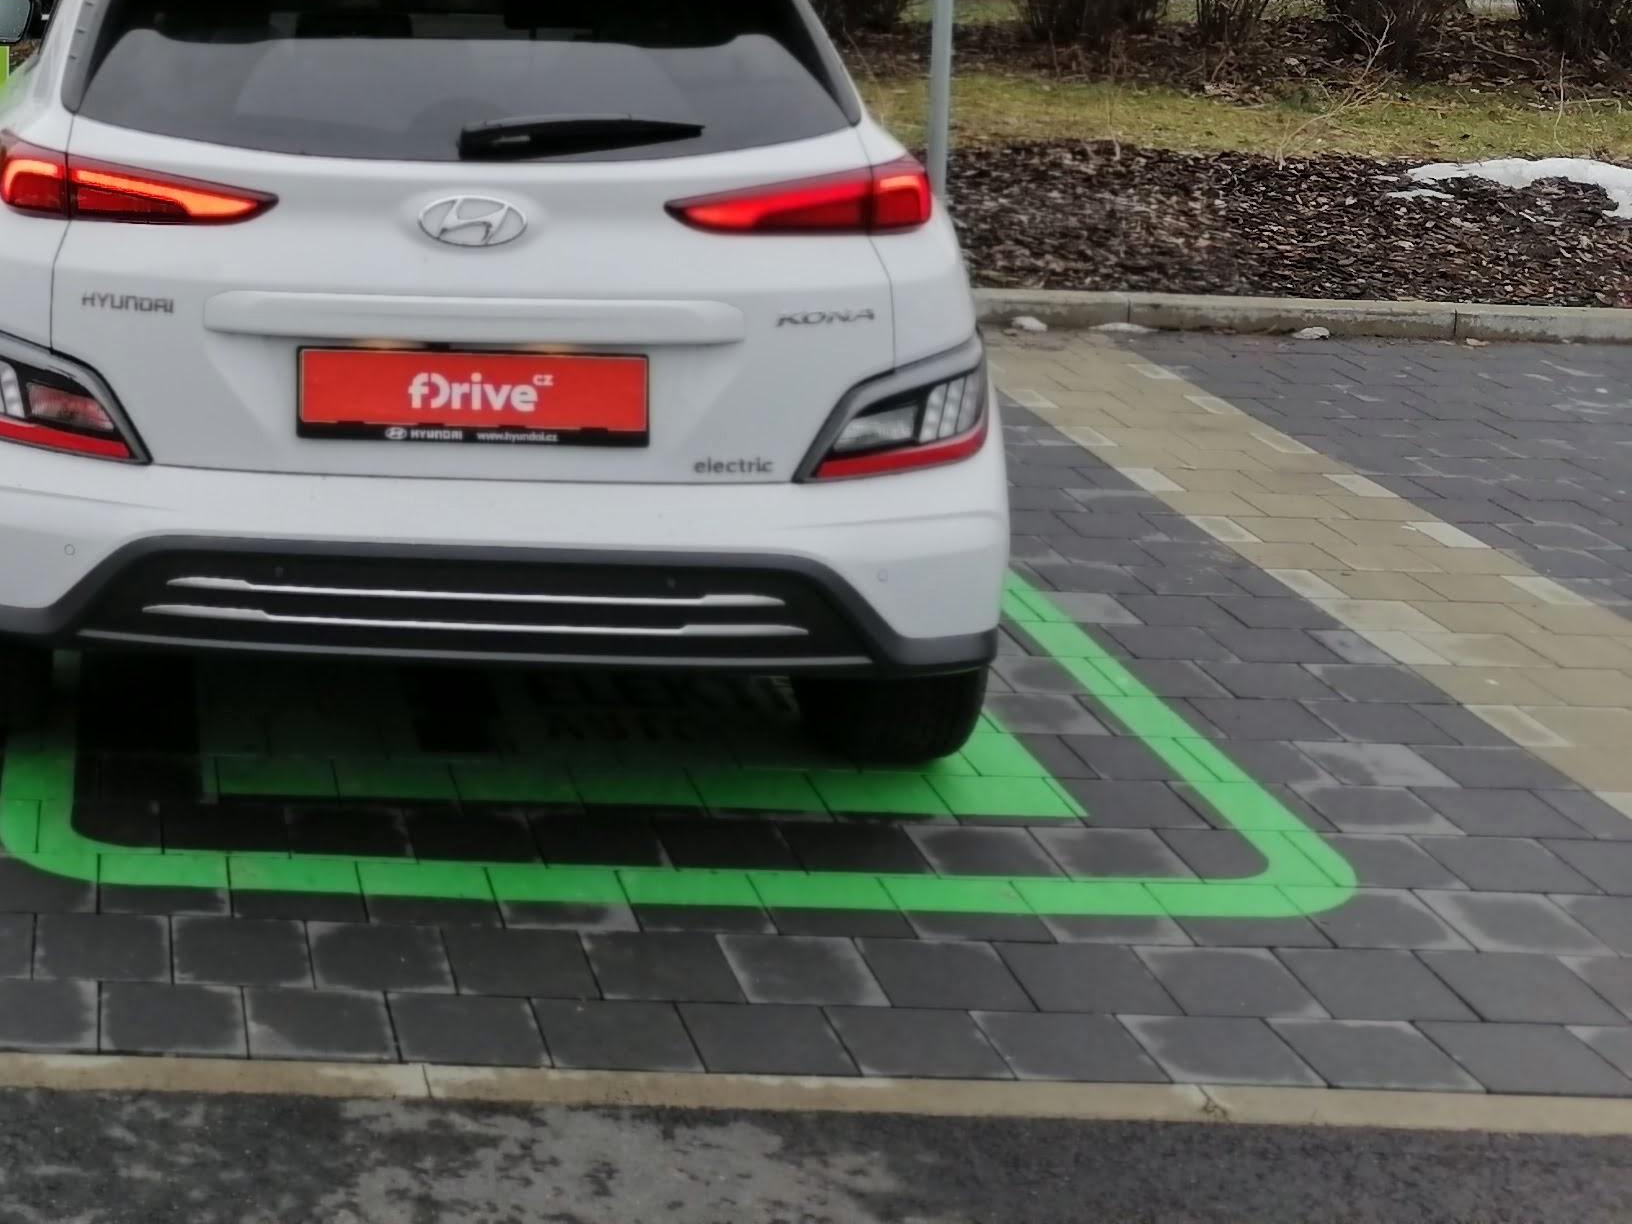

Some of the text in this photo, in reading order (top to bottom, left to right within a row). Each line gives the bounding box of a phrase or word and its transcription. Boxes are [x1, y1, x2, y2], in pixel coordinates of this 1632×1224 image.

[81, 292, 175, 314] HYUNDAI
[410, 429, 463, 440] HYUNDAI
[693, 456, 773, 474] electric
